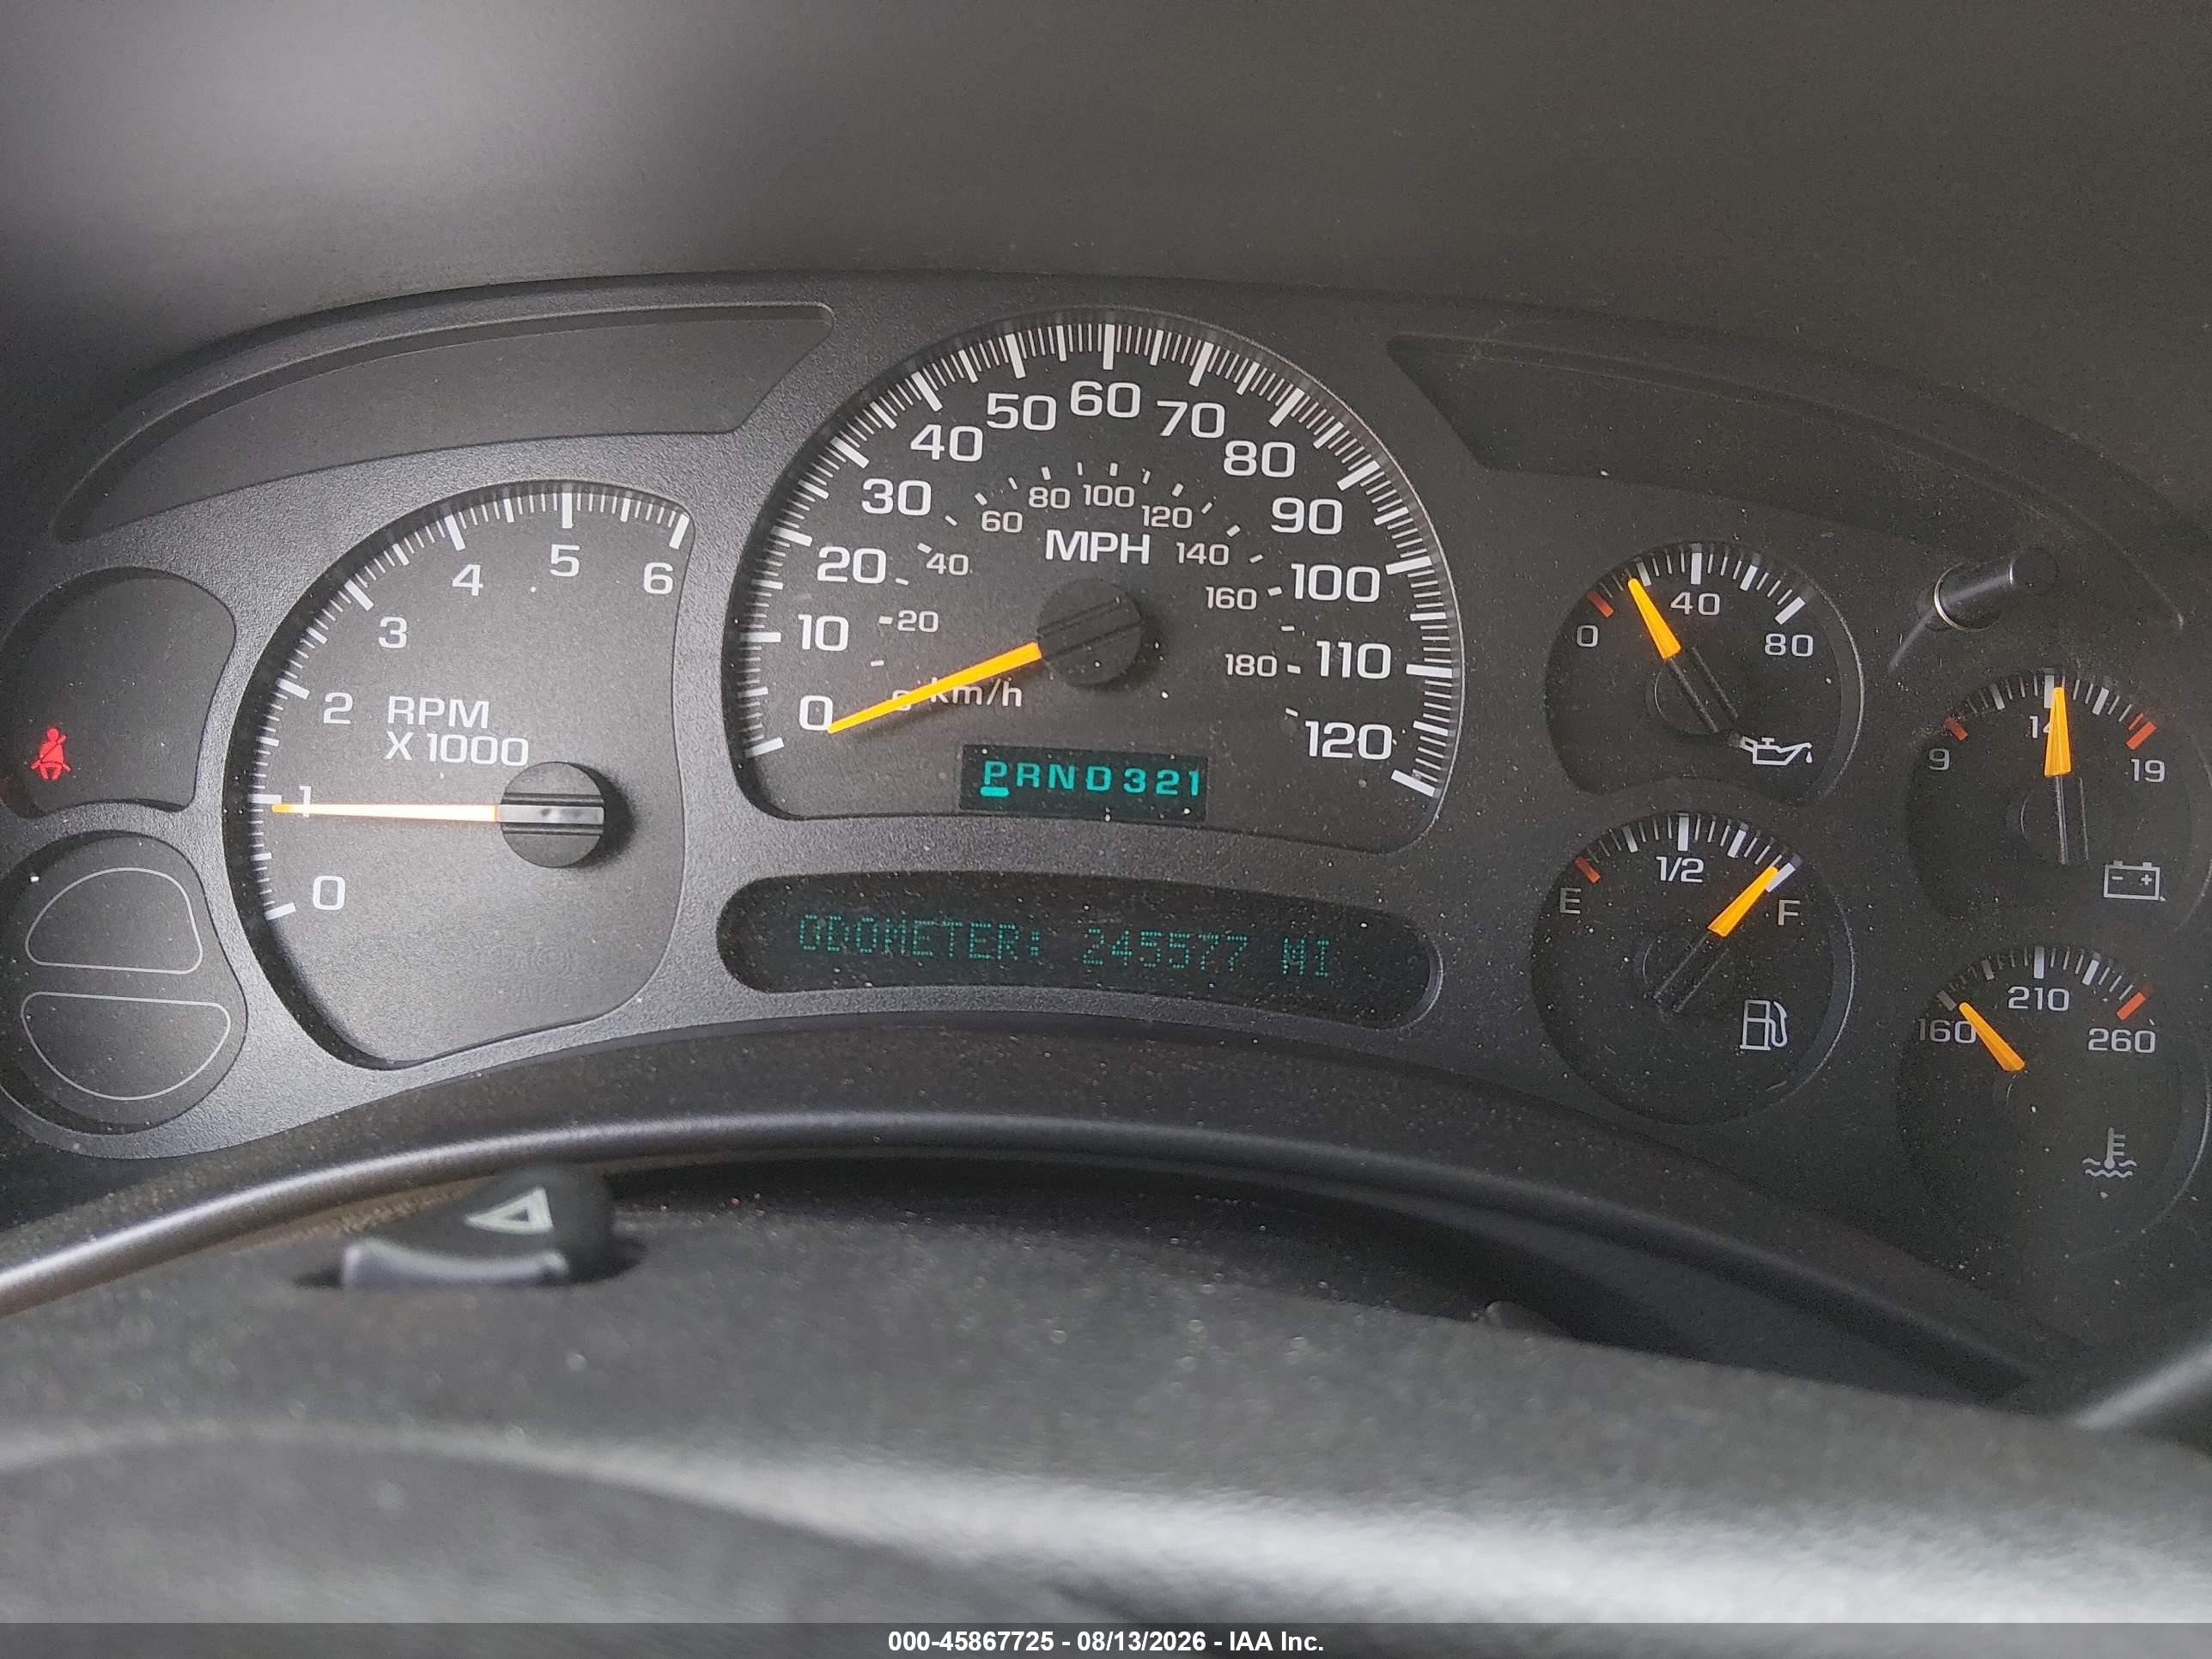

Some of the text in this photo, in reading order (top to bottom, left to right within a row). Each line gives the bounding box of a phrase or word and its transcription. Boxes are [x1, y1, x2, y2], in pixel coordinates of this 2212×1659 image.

[986, 392, 1057, 431] 50
[1070, 380, 1142, 419] 60
[1156, 400, 1225, 439] 70
[910, 423, 983, 462] 40
[1223, 440, 1296, 478] 80
[861, 477, 932, 516] 30
[1029, 486, 1072, 509] 80
[1082, 484, 1135, 508] 100
[981, 510, 1023, 533] 60
[1141, 505, 1193, 529] 120
[1271, 496, 1343, 536] 90
[550, 544, 580, 578] 5
[1045, 528, 1151, 566] MPH
[1176, 542, 1230, 566] 140
[452, 564, 483, 597] 4
[643, 562, 674, 595] 6
[817, 546, 887, 584] 20
[926, 552, 969, 577] 40
[1205, 586, 1258, 611] 160
[1290, 562, 1381, 603] 100
[1671, 592, 1720, 617] 40
[379, 617, 408, 649] 3
[798, 614, 849, 652] 10
[896, 610, 939, 634] 20
[1576, 624, 1599, 649] 0
[1316, 640, 1391, 680] 110
[1764, 633, 1814, 658] 80
[1224, 653, 1278, 678] 180
[323, 692, 353, 725] 2
[386, 695, 489, 729] RPM
[799, 695, 834, 732] 0
[385, 732, 529, 767] X 1000
[1304, 720, 1394, 761] 120
[1928, 748, 1951, 772] 9
[2130, 758, 2166, 783] 19
[299, 784, 312, 818] 1
[1656, 855, 1705, 884] 1/2
[313, 875, 345, 910] 0
[1559, 887, 1582, 915] E
[1778, 899, 1802, 927] F
[798, 913, 1332, 978] ODOMETER: 245577 MI
[2007, 986, 2070, 1012] 210
[1917, 1018, 1977, 1044] 160
[2087, 1027, 2156, 1054] 260
